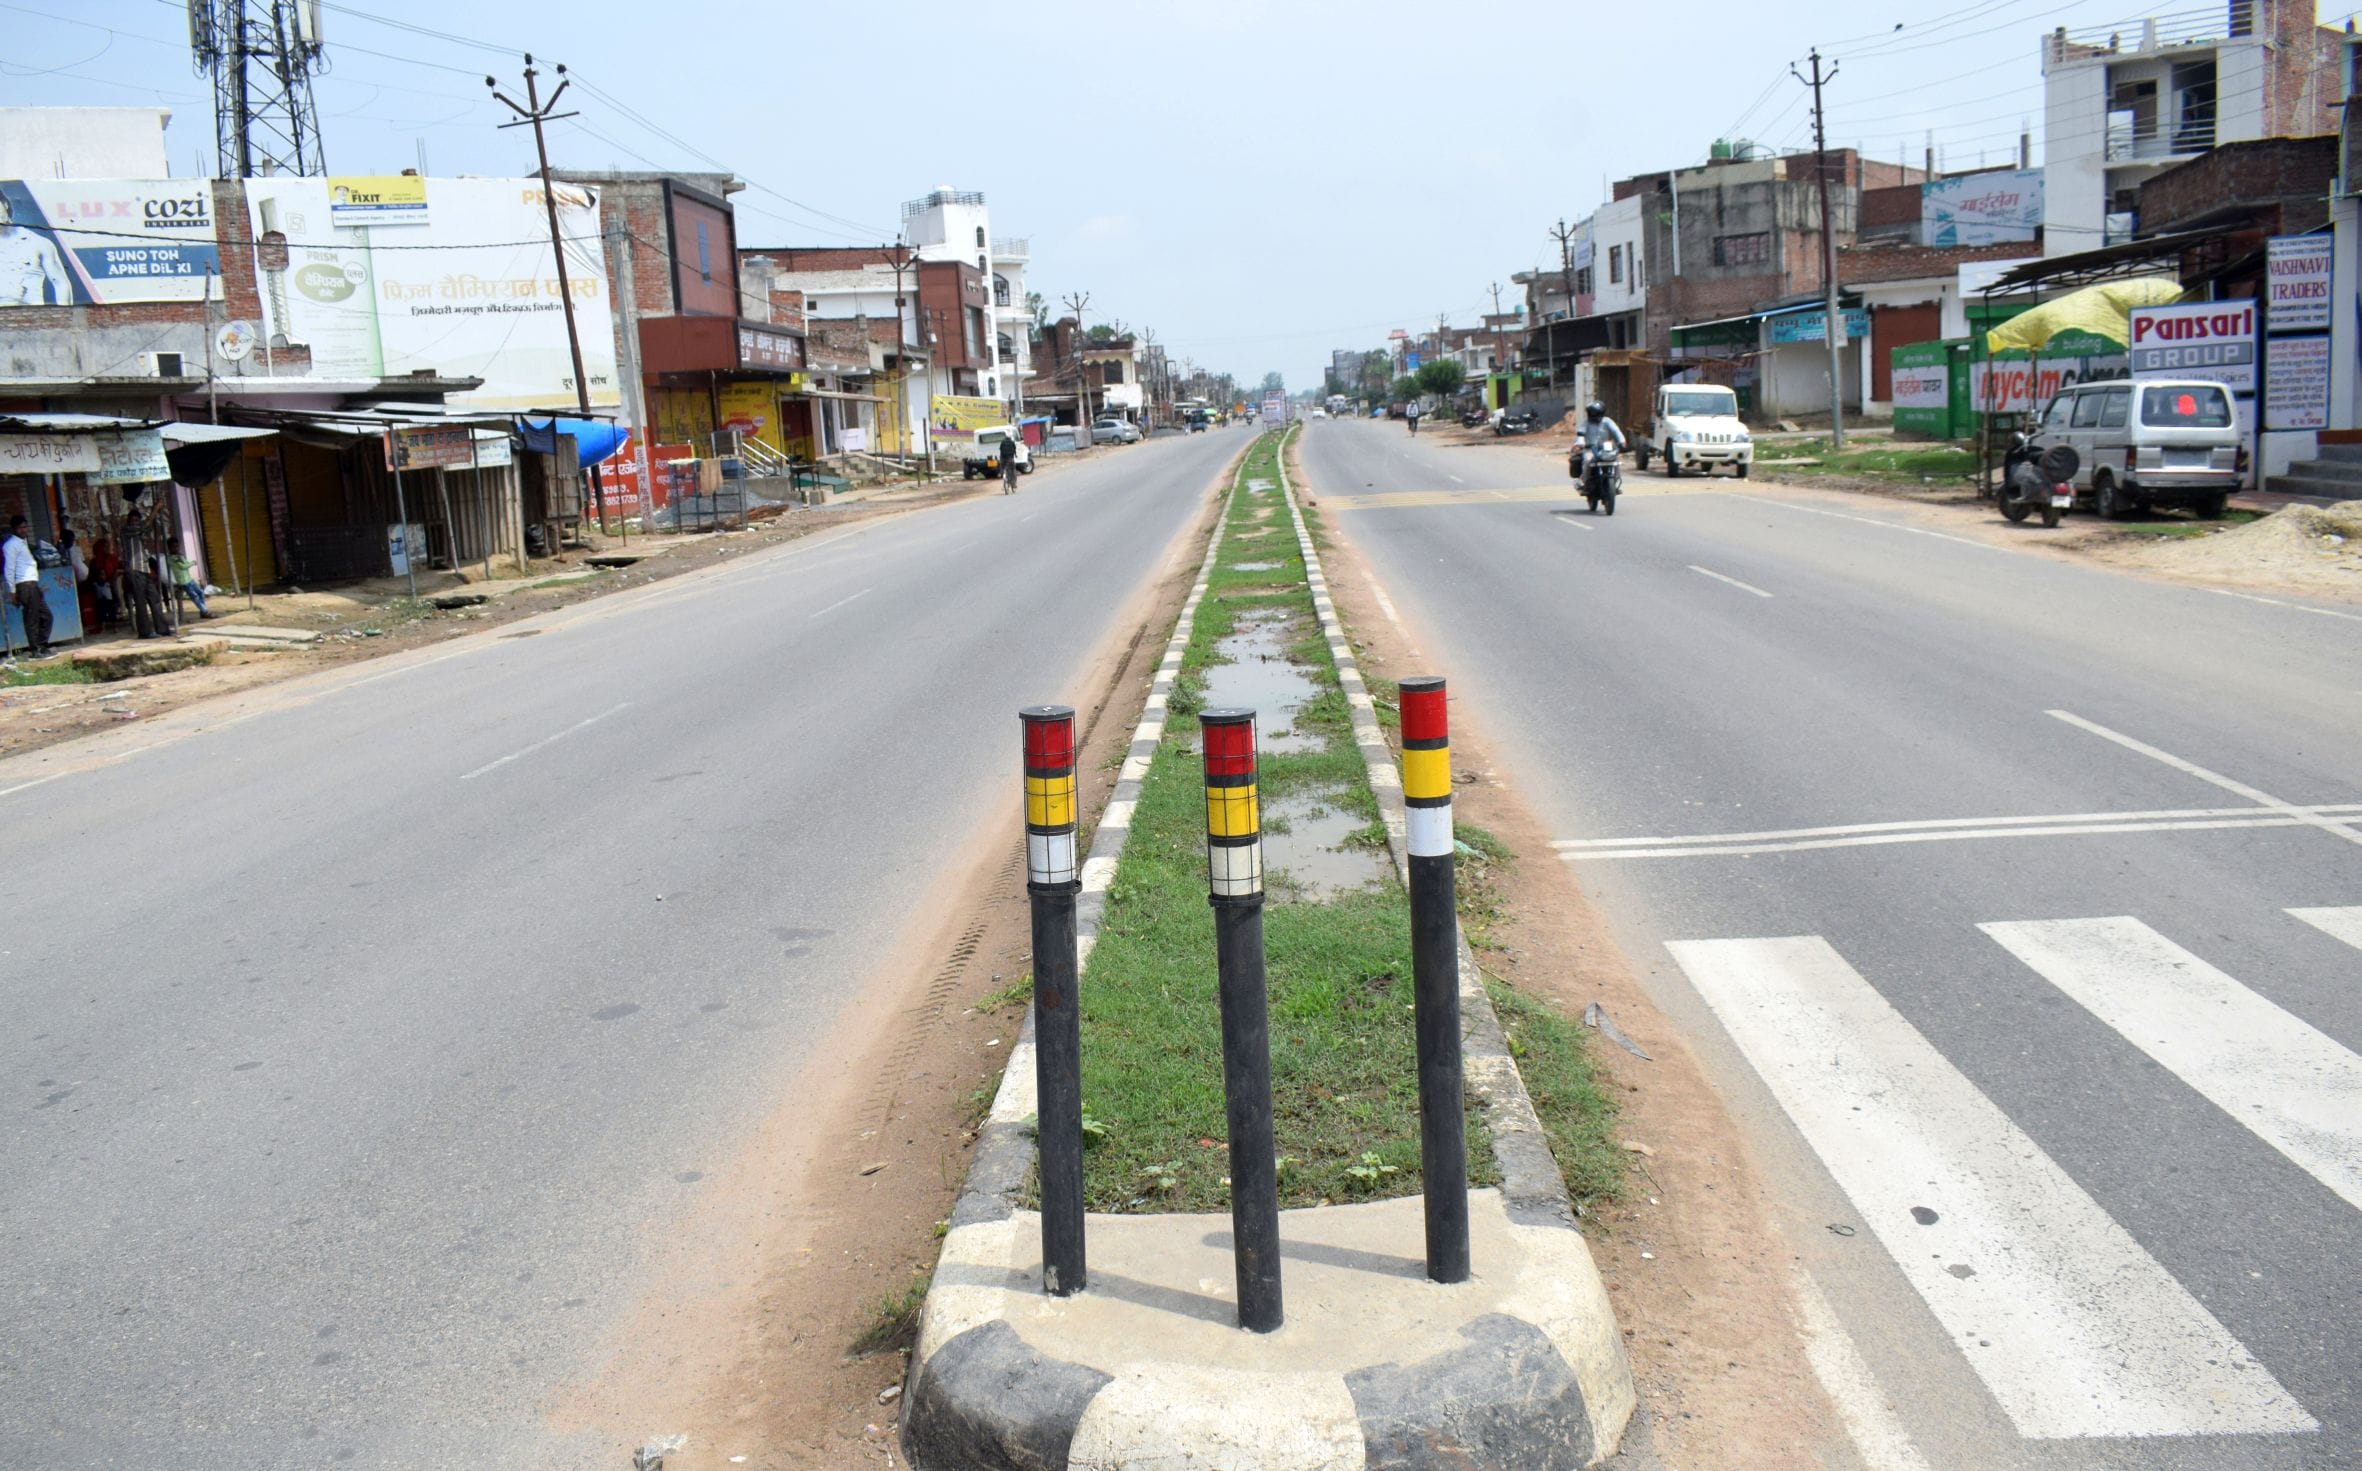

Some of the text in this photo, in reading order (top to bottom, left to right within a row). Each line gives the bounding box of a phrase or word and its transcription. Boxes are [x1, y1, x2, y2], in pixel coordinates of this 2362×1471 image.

[57, 191, 208, 219] LUX cozi
[352, 194, 380, 203] FIXIT
[106, 250, 179, 262] SUNO TOH
[306, 250, 338, 263] PRISM
[108, 264, 148, 275] APNE
[177, 263, 192, 274] KI
[2268, 256, 2329, 276] VAISHNAVI
[2271, 281, 2327, 301] TRADERS
[2146, 344, 2240, 368] GROUP
